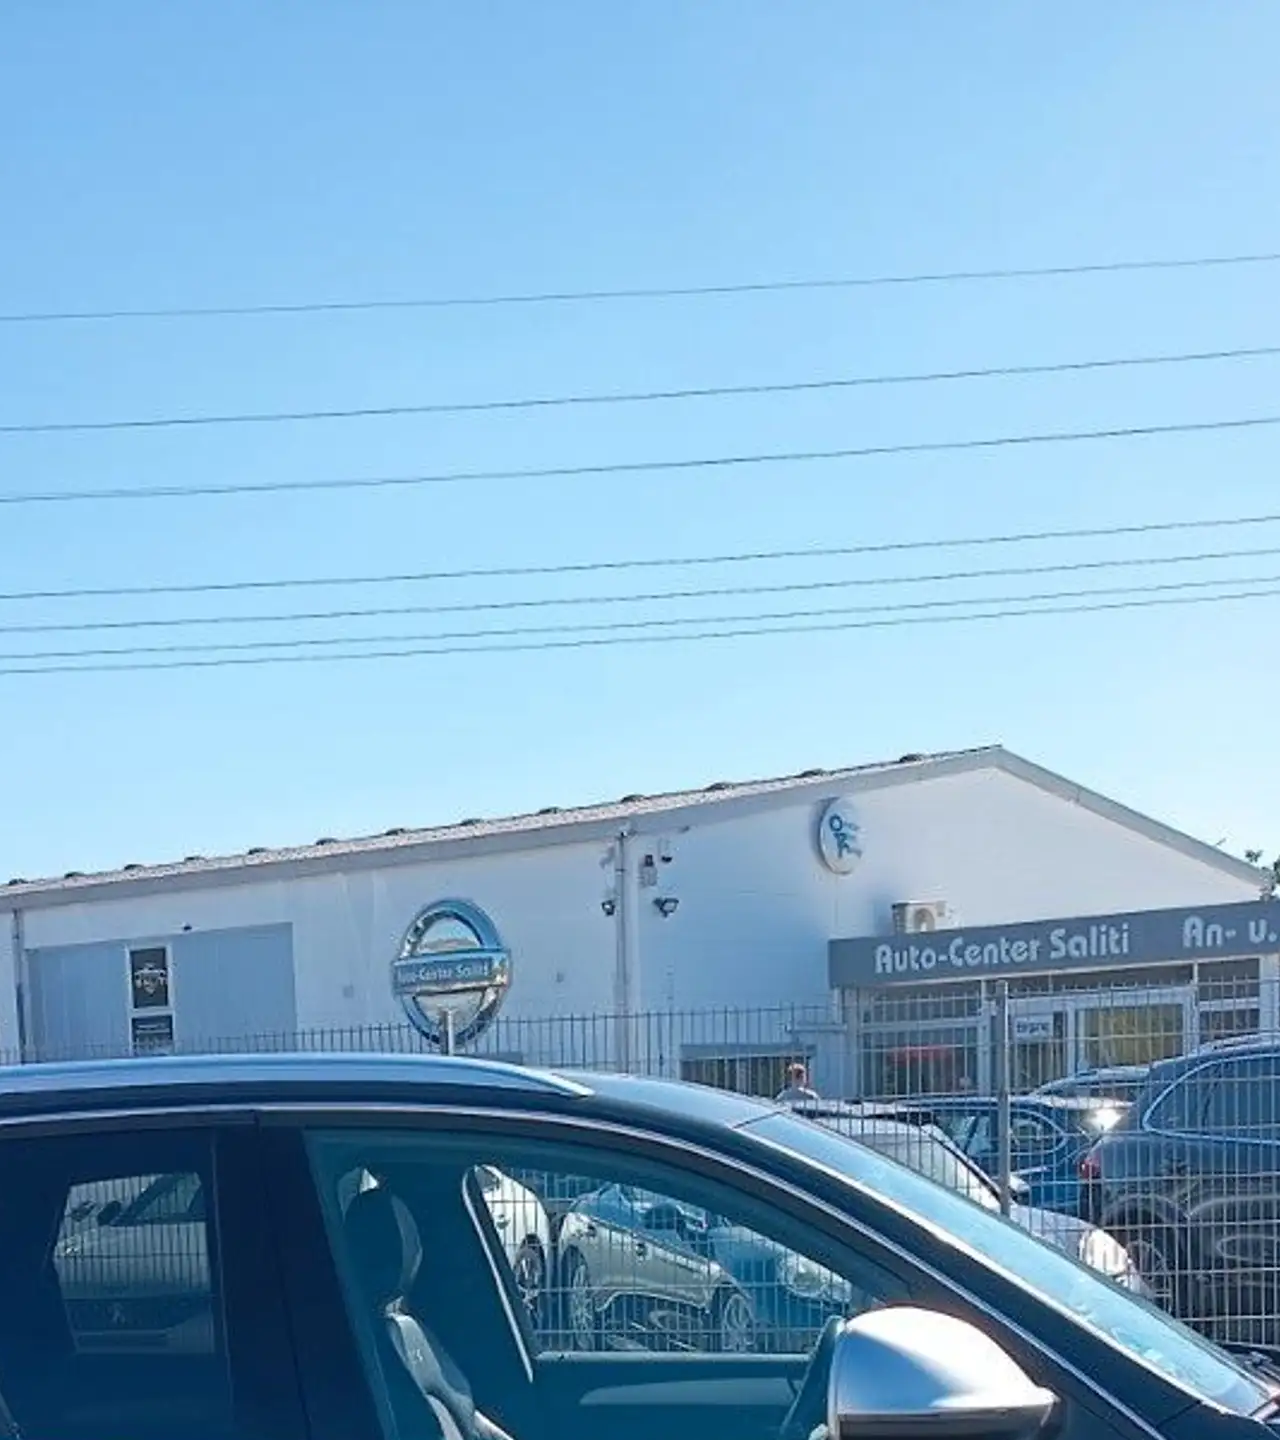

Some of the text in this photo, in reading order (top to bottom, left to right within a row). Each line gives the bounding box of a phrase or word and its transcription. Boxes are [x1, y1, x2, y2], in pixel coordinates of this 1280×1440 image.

[874, 921, 1131, 975] Auto-Center Saliti
[1182, 914, 1237, 949] An-
[1248, 919, 1278, 944] u.
